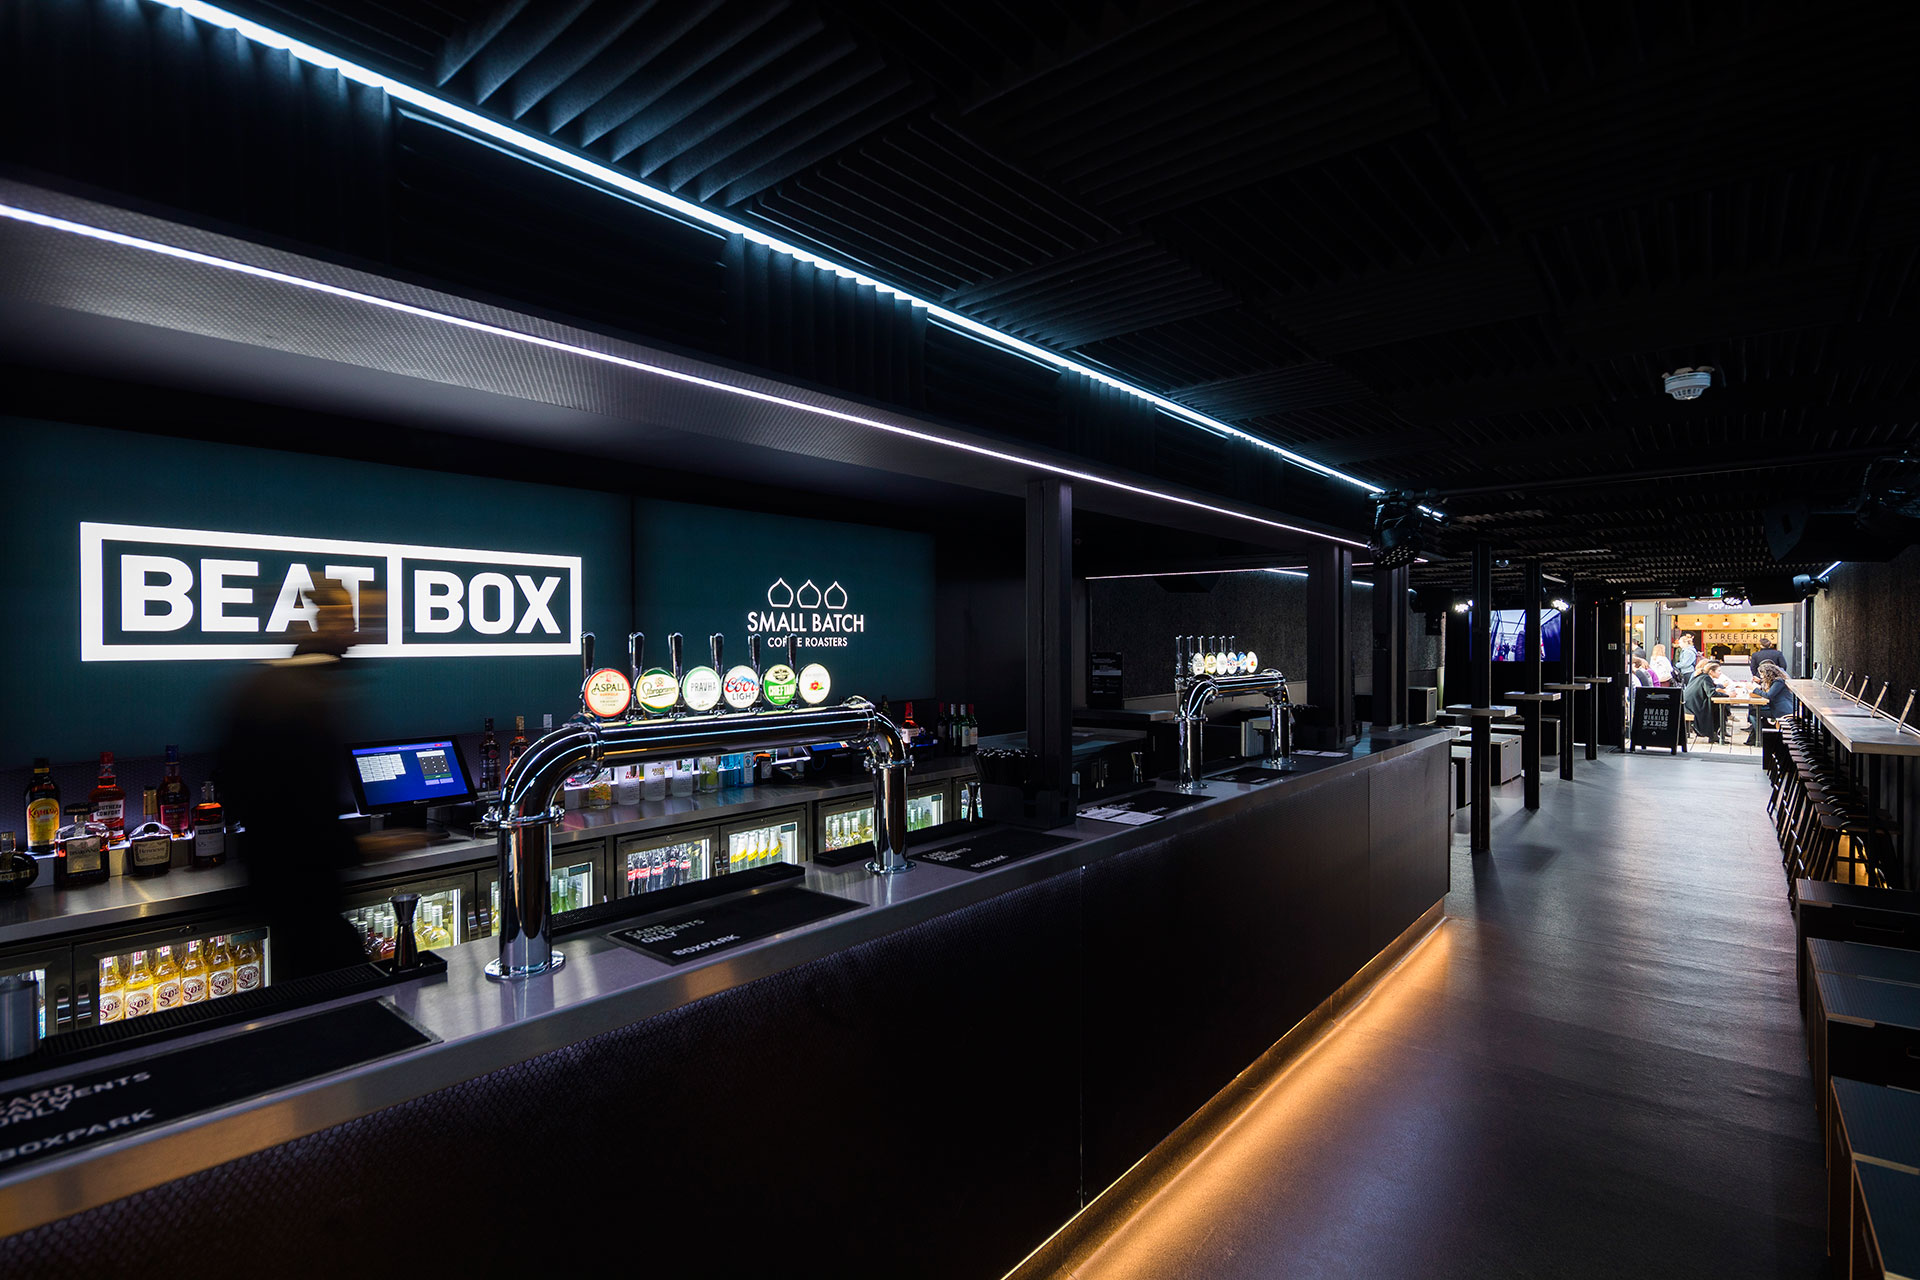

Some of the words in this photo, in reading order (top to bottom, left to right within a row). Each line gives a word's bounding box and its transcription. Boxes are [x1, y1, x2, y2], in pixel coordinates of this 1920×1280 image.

[120, 554, 375, 633] BEAT
[413, 570, 562, 635] BOX
[747, 611, 807, 632] SMALL
[812, 613, 865, 633] BATCH
[767, 636, 803, 648] COFE
[805, 637, 848, 648] ROASTERS
[591, 683, 626, 696] ASPALL
[732, 692, 755, 701] LIGHT
[1643, 708, 1669, 716] AWARD
[624, 924, 666, 937] CARD
[633, 919, 705, 940] PAYMENTS
[640, 931, 678, 944] ONLY
[671, 934, 741, 956] BOXPARK
[0, 1084, 74, 1113] ARD
